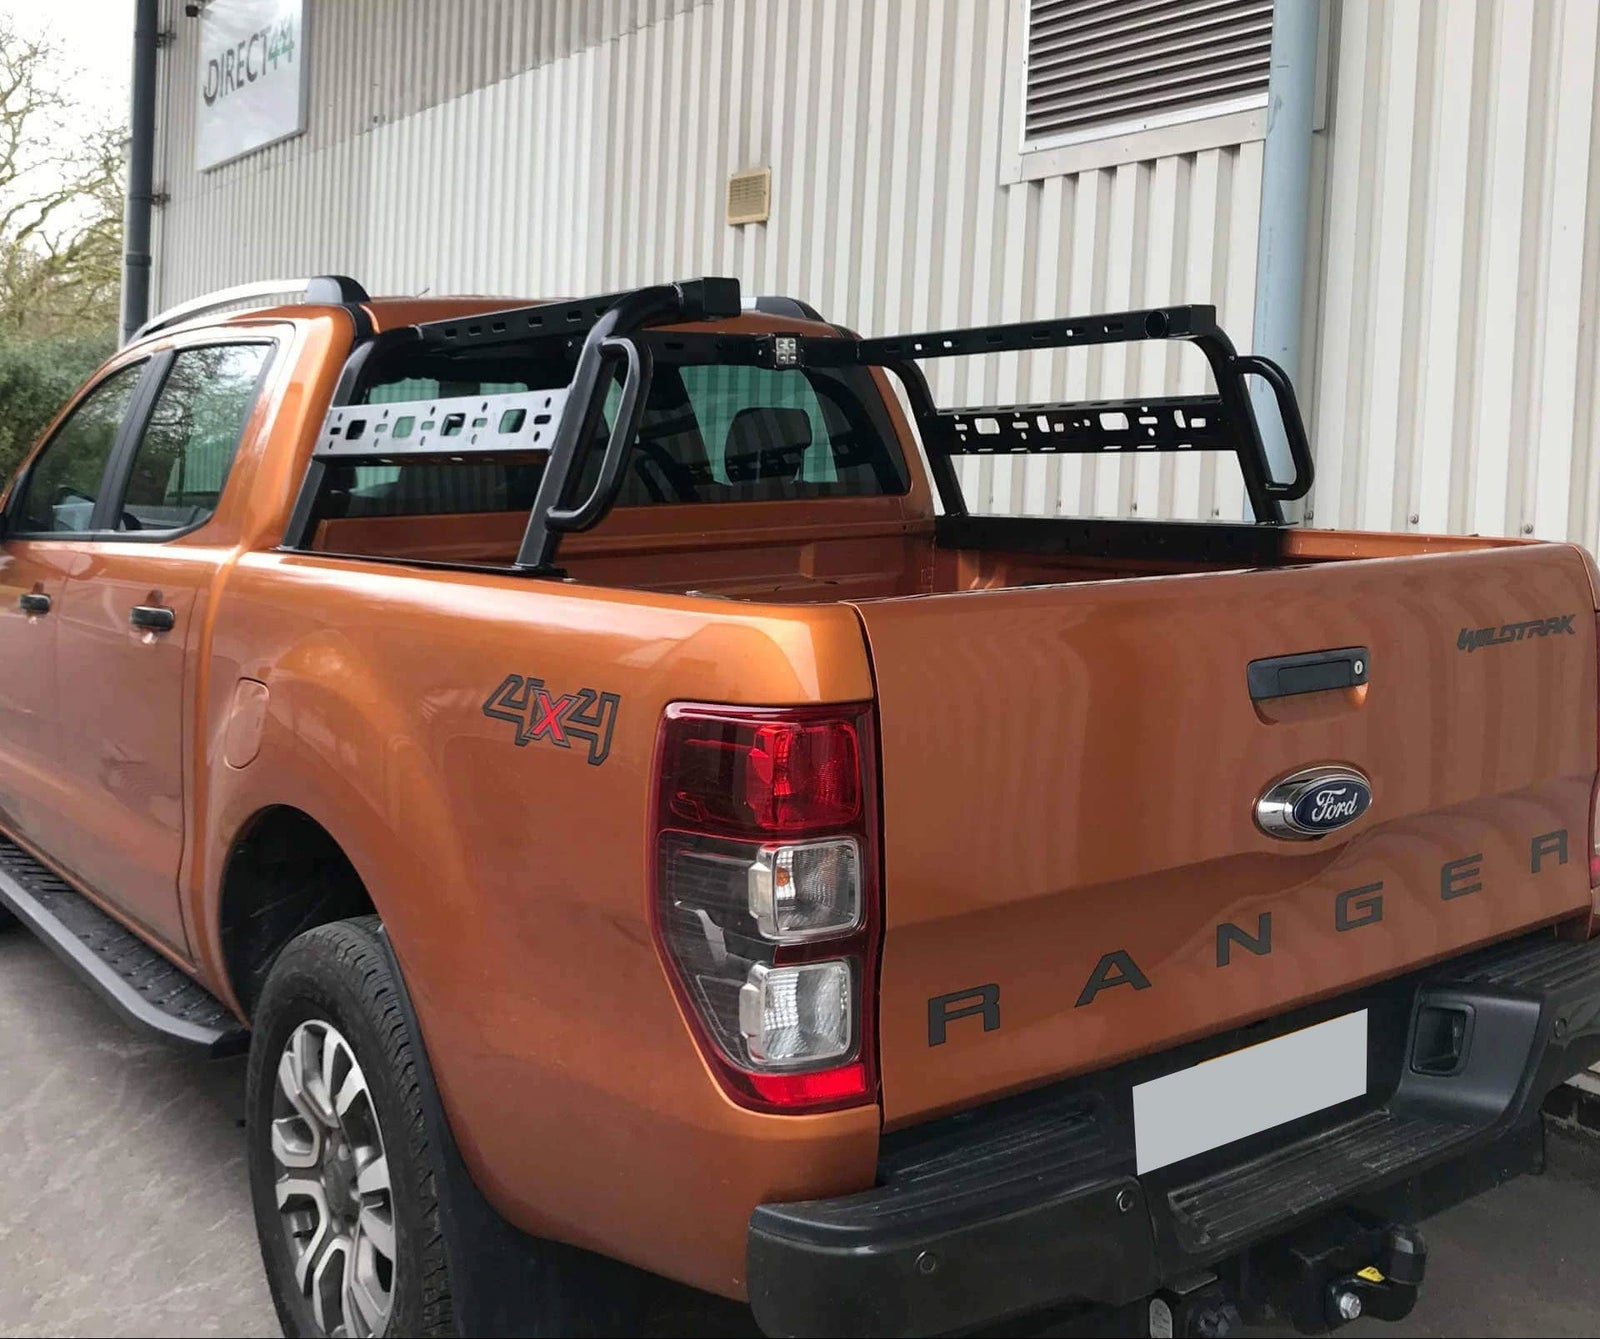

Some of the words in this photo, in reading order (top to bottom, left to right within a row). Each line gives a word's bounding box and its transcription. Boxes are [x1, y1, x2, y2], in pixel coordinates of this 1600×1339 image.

[1457, 615, 1576, 653] WILDTRAK
[1312, 788, 1358, 822] Ford
[928, 829, 1568, 1047] RANGER
